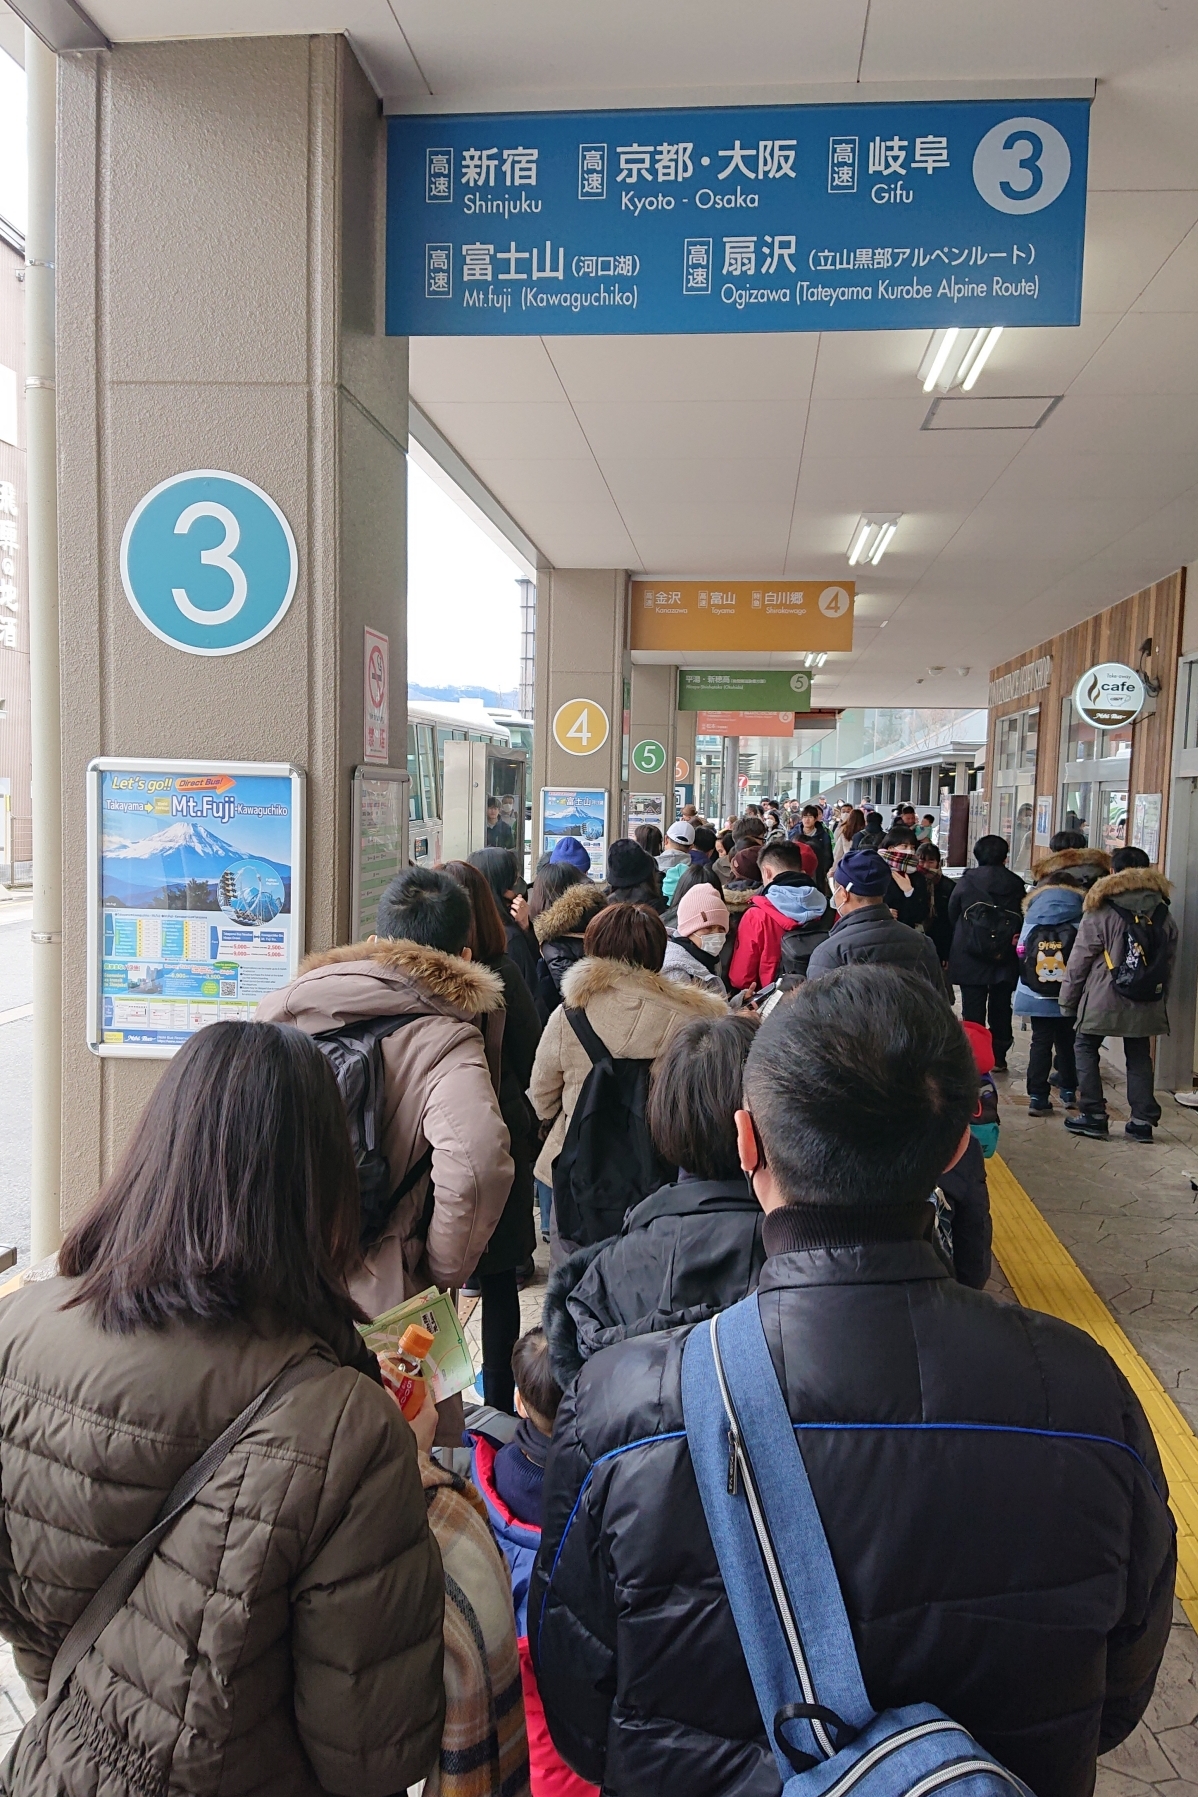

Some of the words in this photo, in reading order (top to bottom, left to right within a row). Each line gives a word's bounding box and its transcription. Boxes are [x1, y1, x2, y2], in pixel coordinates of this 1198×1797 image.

[461, 147, 539, 187] 新宿
[615, 139, 798, 183] 京都・大阪
[832, 143, 854, 187] 高速
[868, 135, 951, 176] 岐阜
[998, 130, 1043, 201] 3
[430, 154, 449, 197] 高速
[583, 150, 603, 193] 高速
[463, 192, 542, 219] Shinjuku
[621, 191, 675, 216] Kyoto
[695, 187, 759, 209] Osaka
[871, 182, 914, 204] Gifu
[461, 241, 564, 281] 富士山
[688, 245, 707, 288] 高速
[722, 234, 797, 276] 扇沢
[430, 250, 448, 292] 高速
[463, 287, 512, 313] Mt.fuji
[521, 284, 638, 312] (Kawaguchiko)
[720, 282, 790, 310] Ogizawa
[796, 281, 872, 307] (Tateyama
[878, 277, 932, 301] Kurobe
[937, 275, 987, 304] Alpine
[992, 274, 1040, 300] Route)
[171, 501, 248, 625] 3
[655, 591, 681, 605] 金沢
[710, 592, 736, 605] 富山
[711, 607, 736, 616] Toyama
[764, 591, 804, 605] 白川郷
[823, 590, 841, 614] 4
[794, 676, 804, 690] 5
[1101, 681, 1136, 693] cafe
[566, 708, 592, 746] 4
[641, 745, 656, 769] 5
[112, 776, 146, 791] Let's
[178, 779, 203, 787] Direct
[204, 777, 224, 786] Bus!
[106, 799, 144, 813] Takayama
